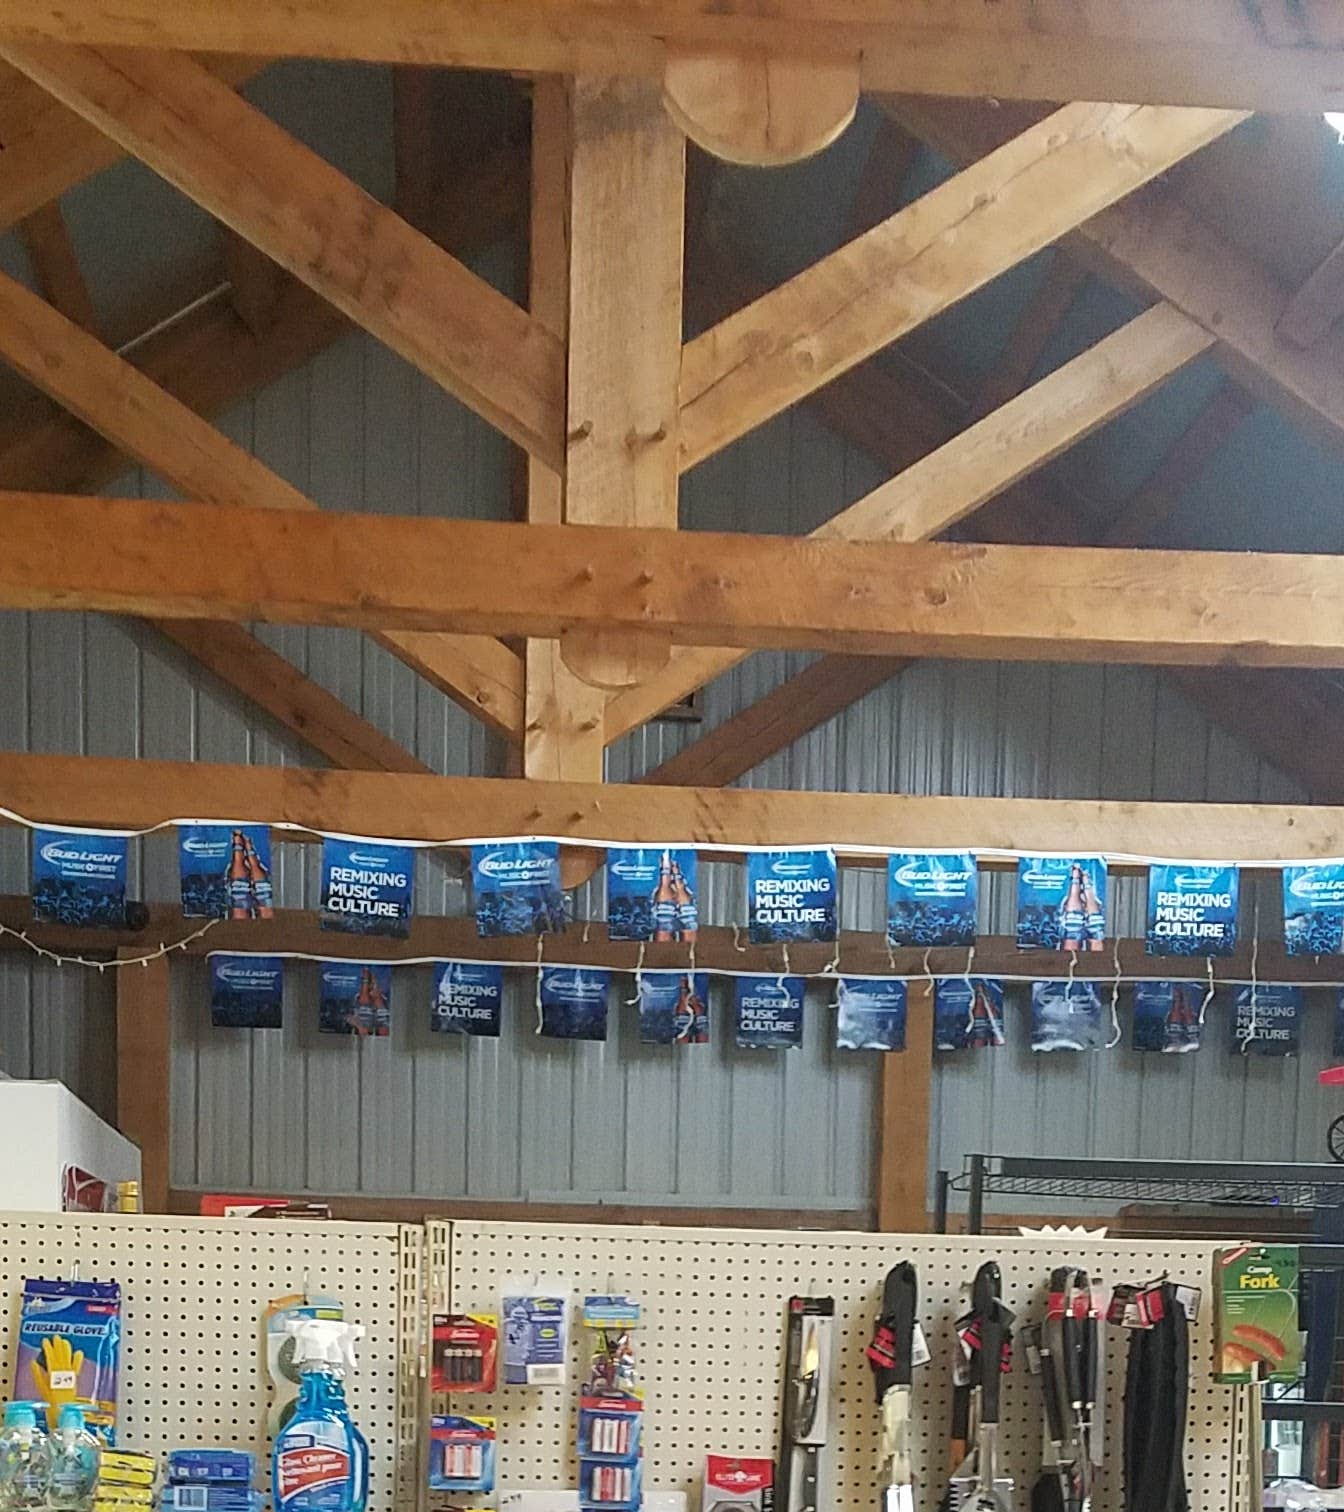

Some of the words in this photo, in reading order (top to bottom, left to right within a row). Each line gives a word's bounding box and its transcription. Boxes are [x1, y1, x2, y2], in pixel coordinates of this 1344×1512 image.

[46, 847, 77, 860] BUD
[78, 850, 122, 864] LIGHT
[485, 859, 513, 871] BUD
[514, 858, 554, 869] LIGHT
[331, 867, 407, 887] REMIXING
[903, 870, 931, 881] BUD
[931, 871, 972, 882] LIGHT
[330, 884, 378, 899] MUSIC
[756, 879, 830, 894] REMIXING
[1297, 880, 1326, 891] BUD
[757, 894, 803, 908] MUSIC
[1157, 893, 1230, 907] REMIXING
[329, 898, 400, 917] CULTURE
[757, 908, 826, 923] CULTURE
[1156, 908, 1204, 922] MUSIC
[1156, 922, 1224, 937] CULTURE
[742, 998, 800, 1010] REMIXING
[742, 1009, 779, 1021] MUSIC
[741, 1020, 795, 1033] CULTURE
[1240, 1275, 1280, 1288] Fork
